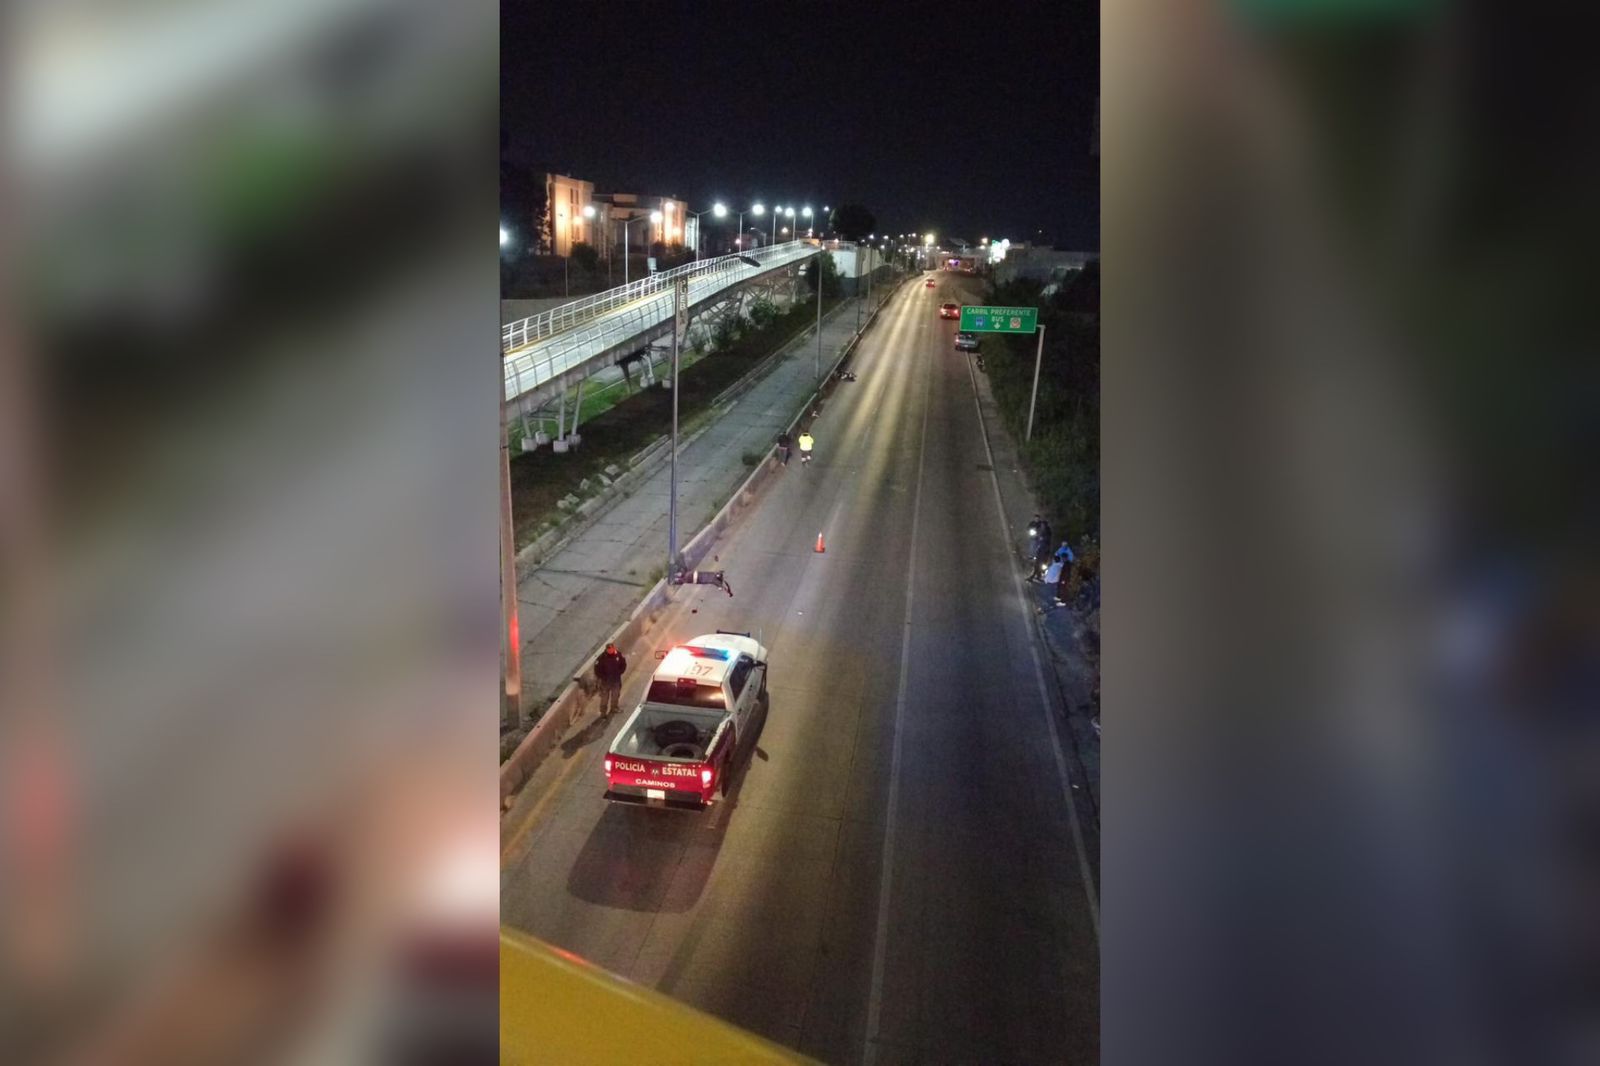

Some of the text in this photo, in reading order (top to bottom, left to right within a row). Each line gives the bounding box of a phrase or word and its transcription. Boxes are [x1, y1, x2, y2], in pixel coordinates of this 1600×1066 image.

[966, 307, 1031, 316] CARRIL PREFERENTE
[662, 767, 697, 777] ESTATAL
[635, 778, 676, 788] CAMINOS
